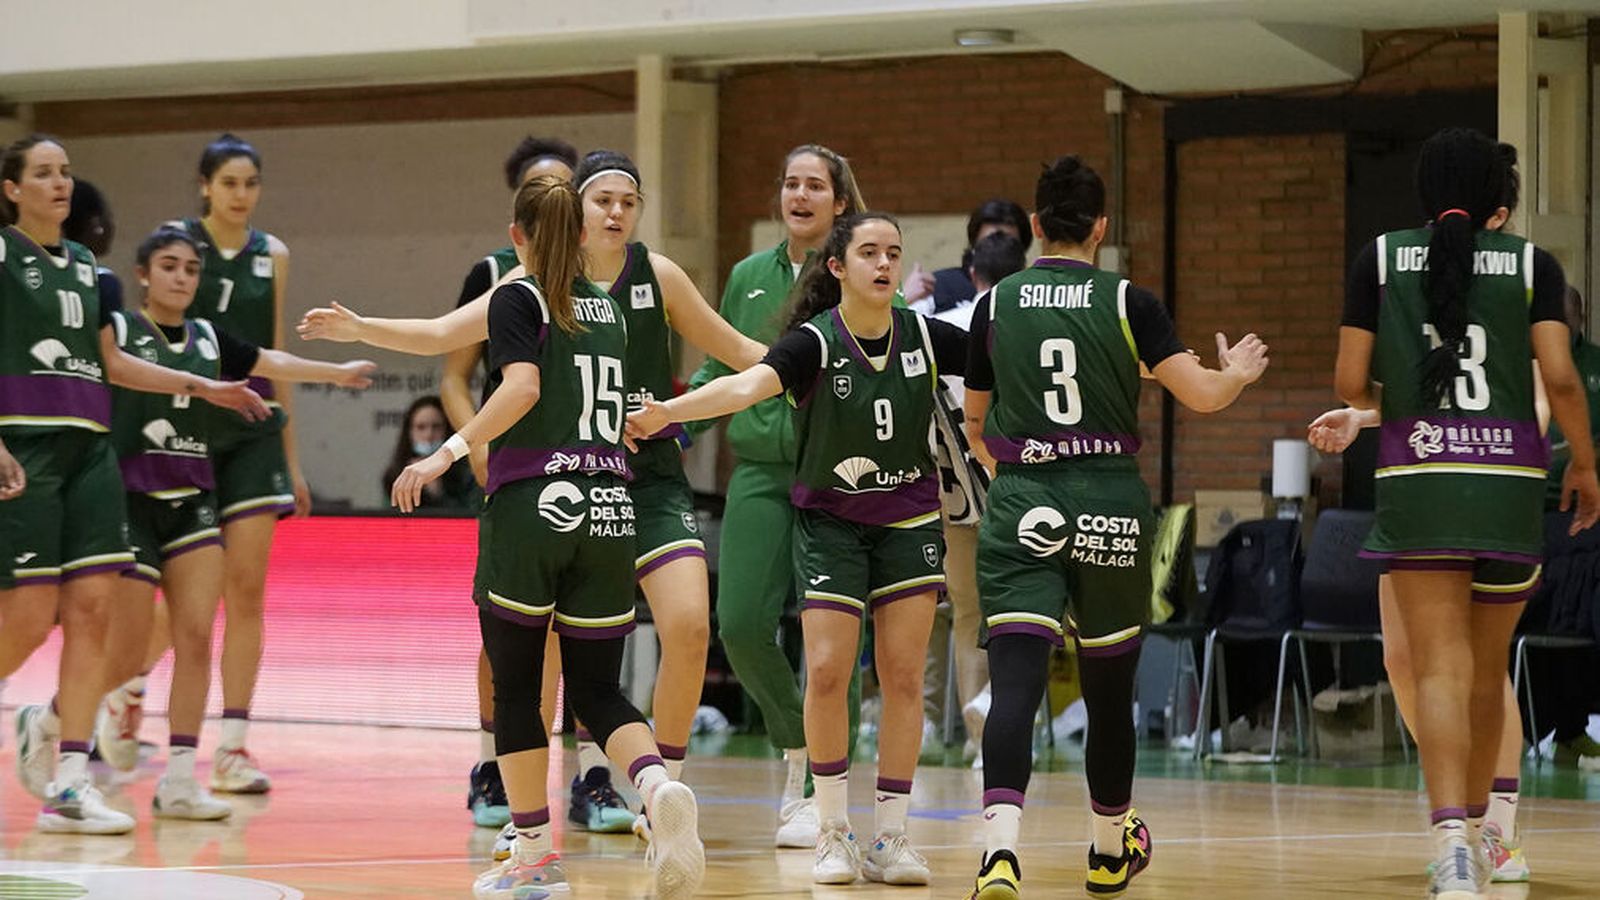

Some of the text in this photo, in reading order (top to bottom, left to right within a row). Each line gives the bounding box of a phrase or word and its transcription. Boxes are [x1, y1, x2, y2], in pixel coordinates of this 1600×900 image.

[57, 289, 84, 329] 10
[1019, 279, 1093, 309] SALOMÉ
[1040, 338, 1083, 425] 3
[574, 354, 624, 445] 15
[874, 398, 894, 441] 9
[590, 506, 619, 520] DEL
[1077, 513, 1140, 535] COSTA
[1074, 533, 1138, 552] DEL SOL
[1071, 549, 1136, 567] MÁLAGA
